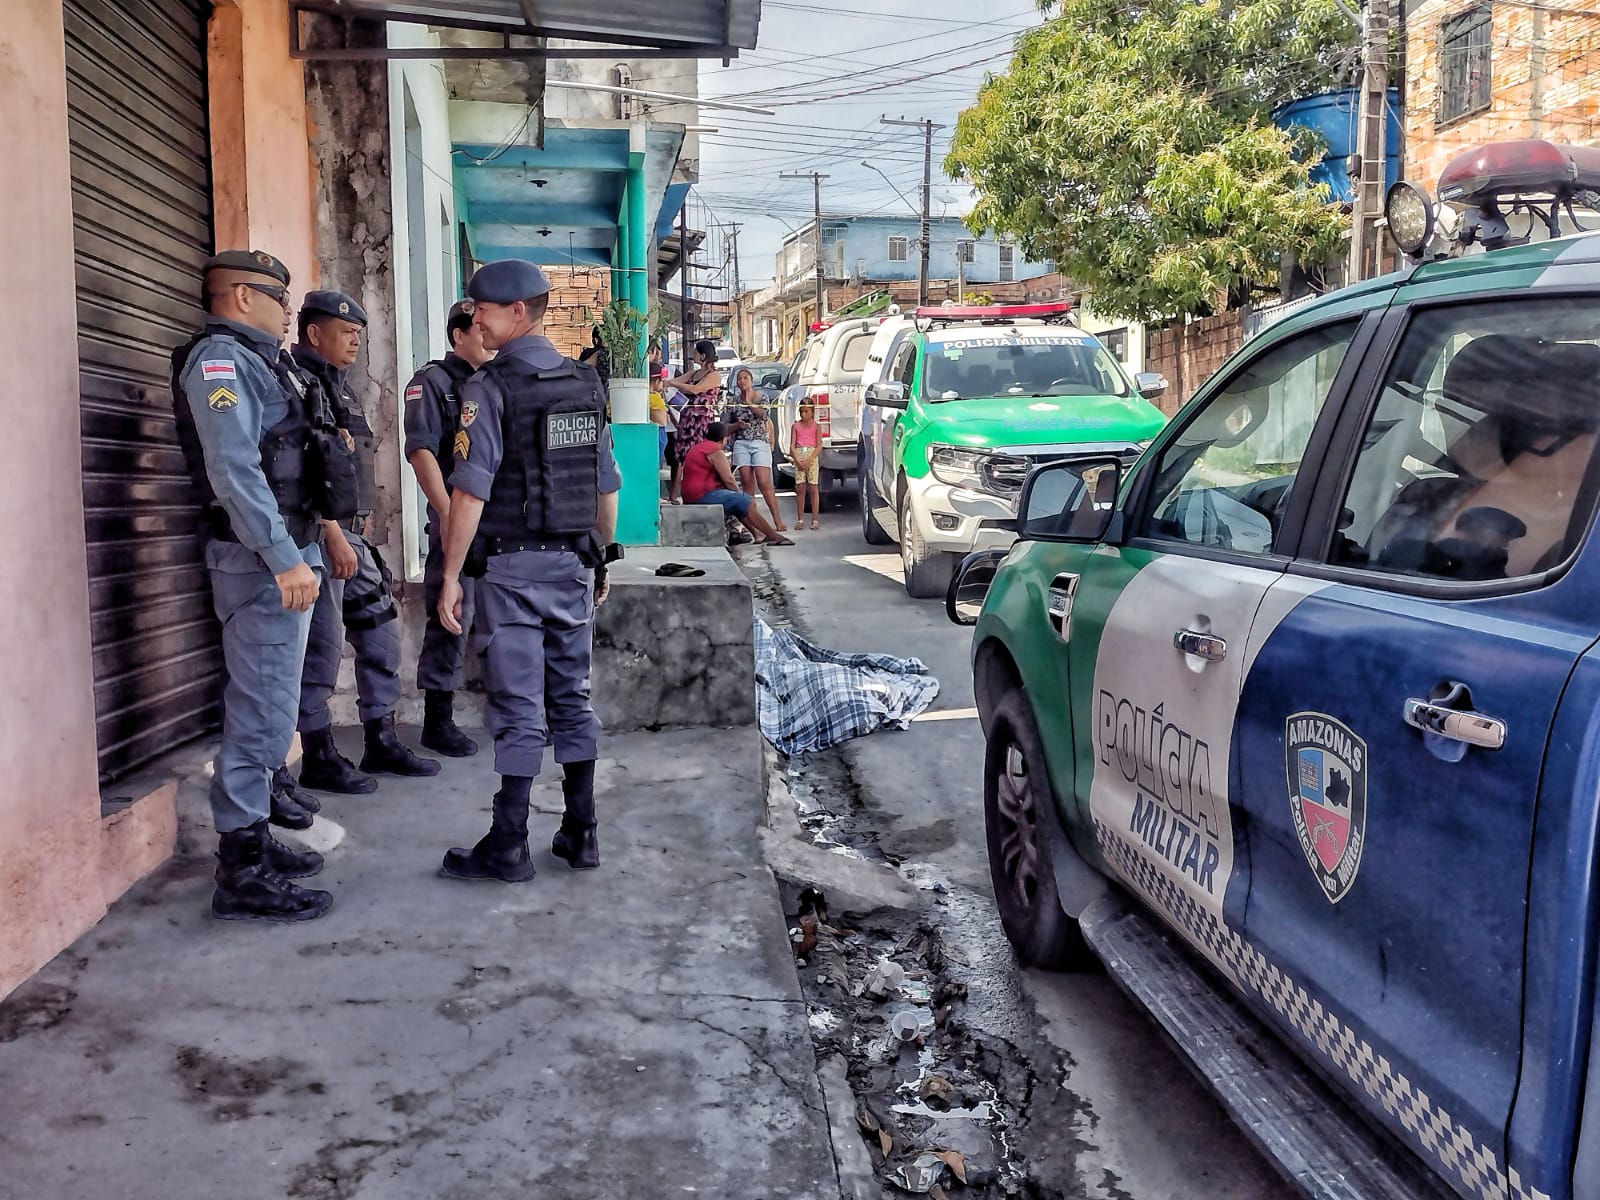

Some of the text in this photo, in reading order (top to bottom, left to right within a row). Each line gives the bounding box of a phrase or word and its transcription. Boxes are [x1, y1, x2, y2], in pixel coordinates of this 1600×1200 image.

[1015, 337, 1084, 346] MILITAR
[550, 429, 597, 447] MILITAR
[1100, 688, 1219, 840] POLÍCIA
[1289, 719, 1362, 773] AMAZONAS
[1130, 791, 1219, 895] MILITAR
[1337, 825, 1362, 888] Militar
